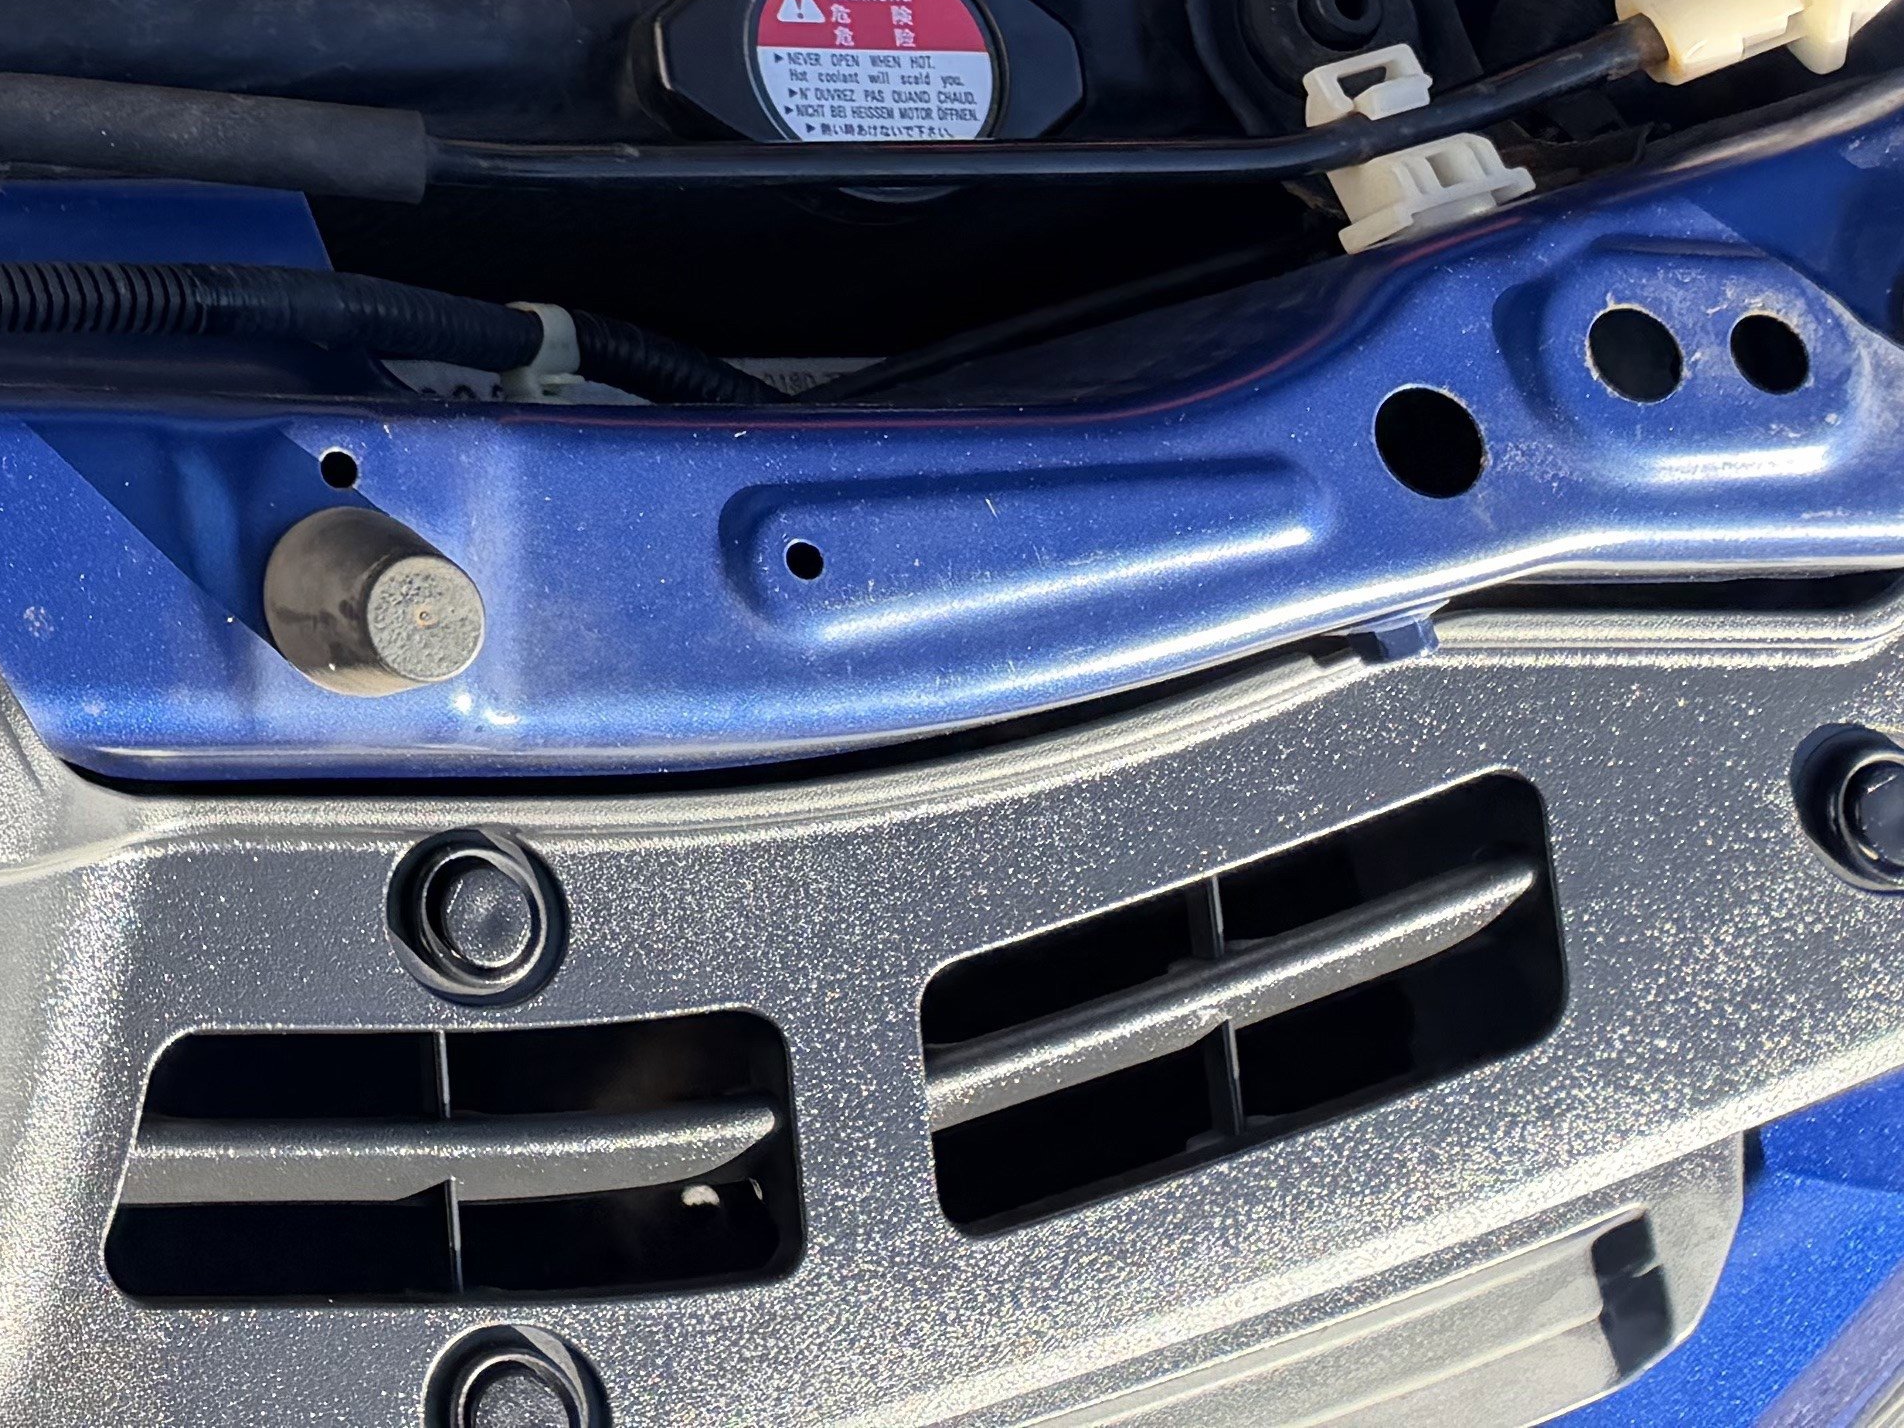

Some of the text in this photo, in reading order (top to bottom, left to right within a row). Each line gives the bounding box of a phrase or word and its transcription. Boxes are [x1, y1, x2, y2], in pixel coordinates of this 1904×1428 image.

[787, 52, 936, 70] NEVER OPEN WHEN HOT.
[789, 70, 964, 88] Hot coolant will scald you.
[864, 90, 977, 105] PAS QUAND CHAUD.
[796, 105, 825, 118] NICHT
[831, 106, 847, 119] BEI
[851, 106, 894, 120] HEISSEM
[899, 107, 934, 121] MOTOR
